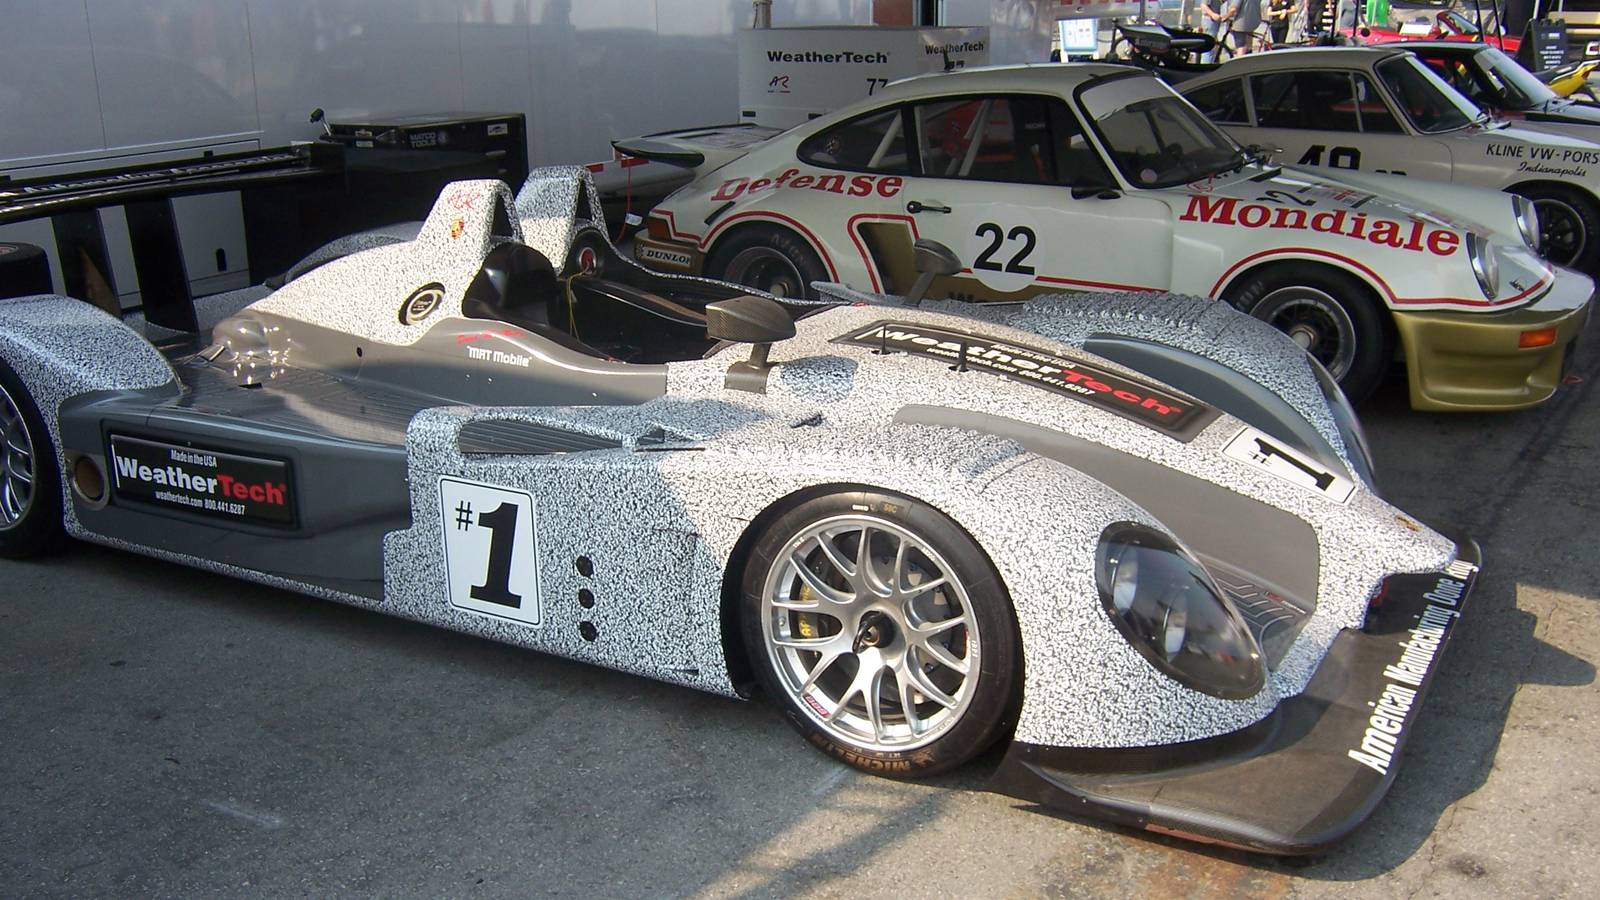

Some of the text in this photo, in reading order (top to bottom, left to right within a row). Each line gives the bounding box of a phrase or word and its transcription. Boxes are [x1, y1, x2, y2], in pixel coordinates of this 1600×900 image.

[767, 51, 887, 63] WeatherTech
[925, 42, 983, 55] WeatherTech
[1486, 143, 1524, 158] KLINE
[1517, 161, 1586, 177] Indianapolis
[710, 168, 903, 201] Defense
[1180, 194, 1460, 256] Mondiale
[973, 222, 1036, 275] 22
[493, 351, 529, 367] Mobile
[1050, 358, 1076, 369] USA
[875, 329, 1172, 415] WeatherTech
[171, 449, 217, 468] Made in the USA
[117, 455, 286, 505] WeatherTech
[155, 490, 246, 516] weathertech.com 800.441.6287
[1348, 683, 1417, 776] American
[1383, 603, 1461, 687] Manufacturing
[1422, 577, 1466, 606] Done
